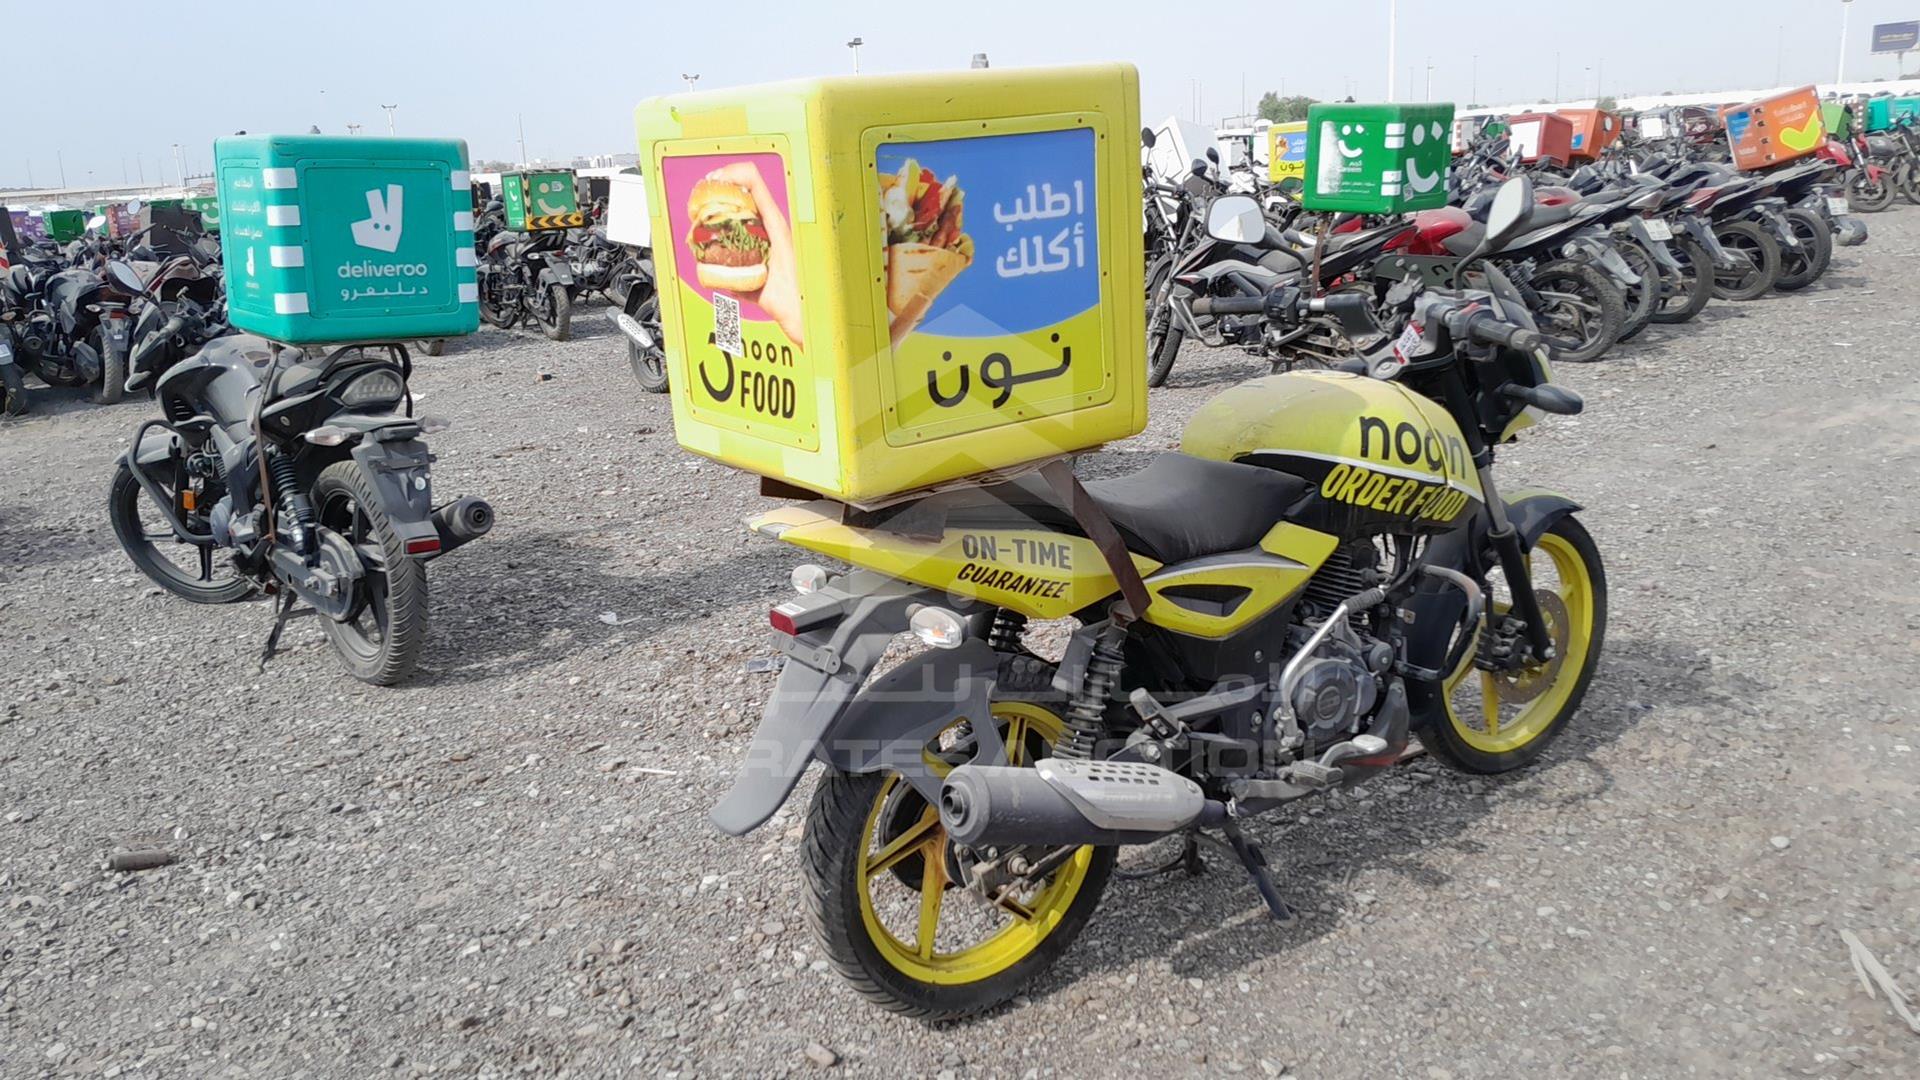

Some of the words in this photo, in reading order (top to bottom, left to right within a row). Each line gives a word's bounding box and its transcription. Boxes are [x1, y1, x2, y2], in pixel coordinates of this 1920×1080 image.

[993, 179, 1084, 231] اطلب
[337, 259, 428, 278] deliveroo
[996, 222, 1084, 278] أكلك
[340, 281, 428, 301] ديليفرو
[740, 370, 796, 419] FOOD
[926, 332, 1072, 409] نون
[1359, 416, 1466, 480] noon
[1320, 463, 1419, 515] ORDER
[1404, 485, 1470, 522] FOOD
[962, 534, 1073, 571] ON-TIME
[957, 562, 1071, 599] GUARANTEE
